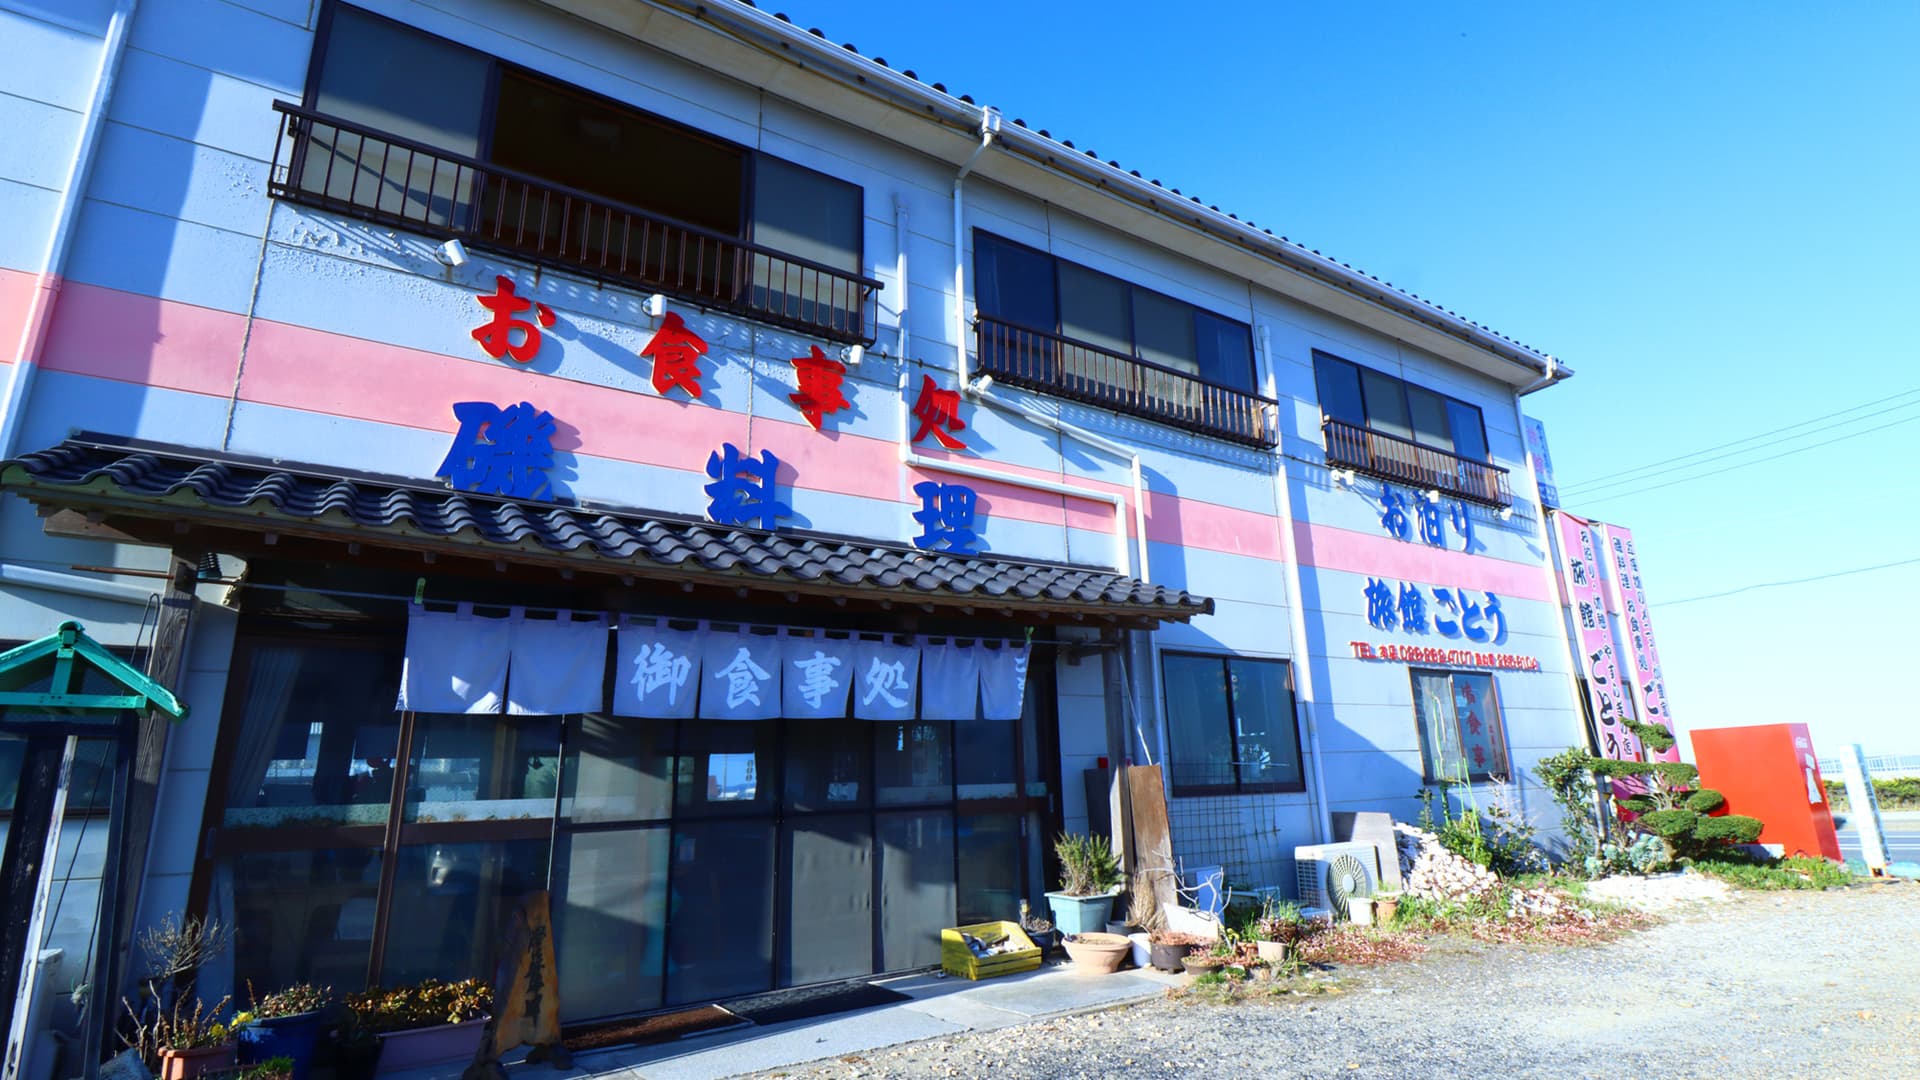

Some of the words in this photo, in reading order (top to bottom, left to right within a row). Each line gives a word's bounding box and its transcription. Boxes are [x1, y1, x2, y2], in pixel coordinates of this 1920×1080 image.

[471, 275, 968, 451] お食事処
[435, 401, 979, 555] 磯料理
[1379, 483, 1472, 552] お泊り
[630, 642, 910, 710] 御食事処
[1350, 641, 1376, 659] TEL
[1571, 558, 1620, 761] 旅館ごとう
